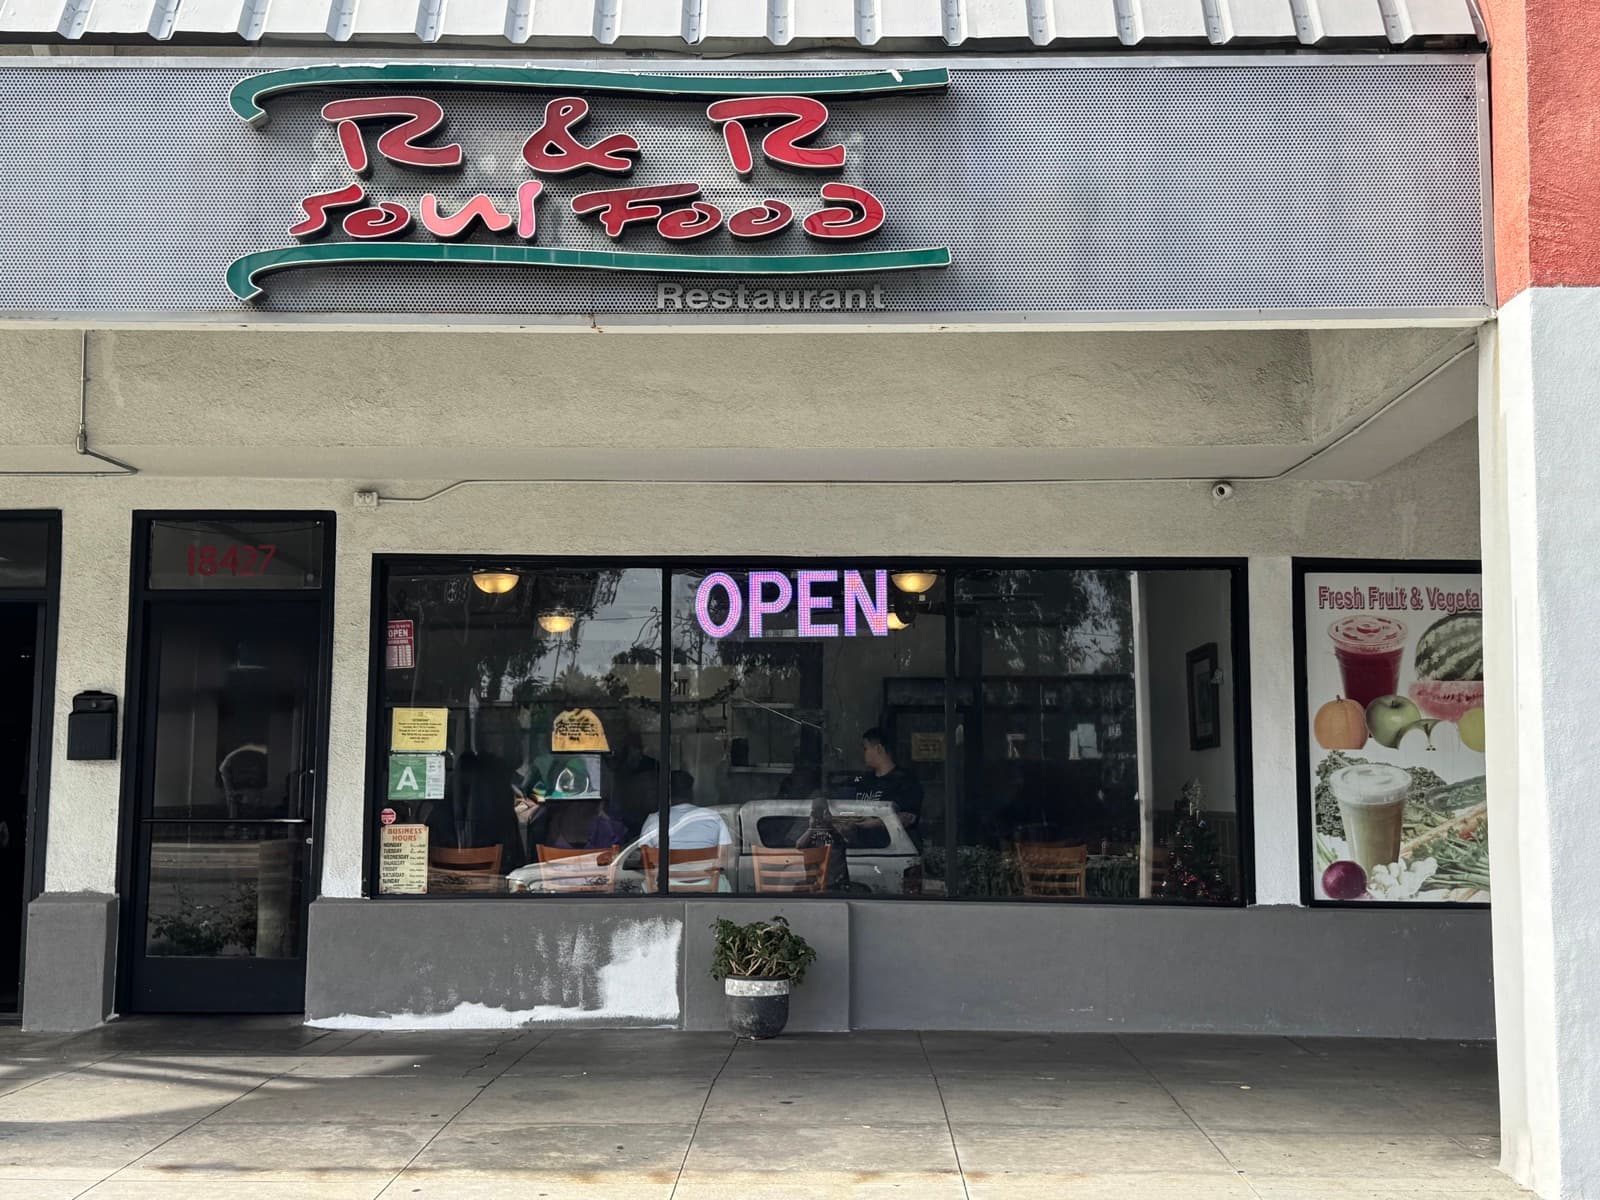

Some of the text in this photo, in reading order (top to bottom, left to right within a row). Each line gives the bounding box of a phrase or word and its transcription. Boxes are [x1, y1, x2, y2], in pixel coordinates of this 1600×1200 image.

[322, 95, 846, 173] R & R
[656, 282, 885, 310] Restaurant
[187, 545, 277, 577] 18427
[695, 570, 889, 638] OPEN
[1318, 586, 1482, 615] Fresh Fruit & Vegeta
[388, 629, 409, 638] OPEN
[396, 766, 419, 790] A
